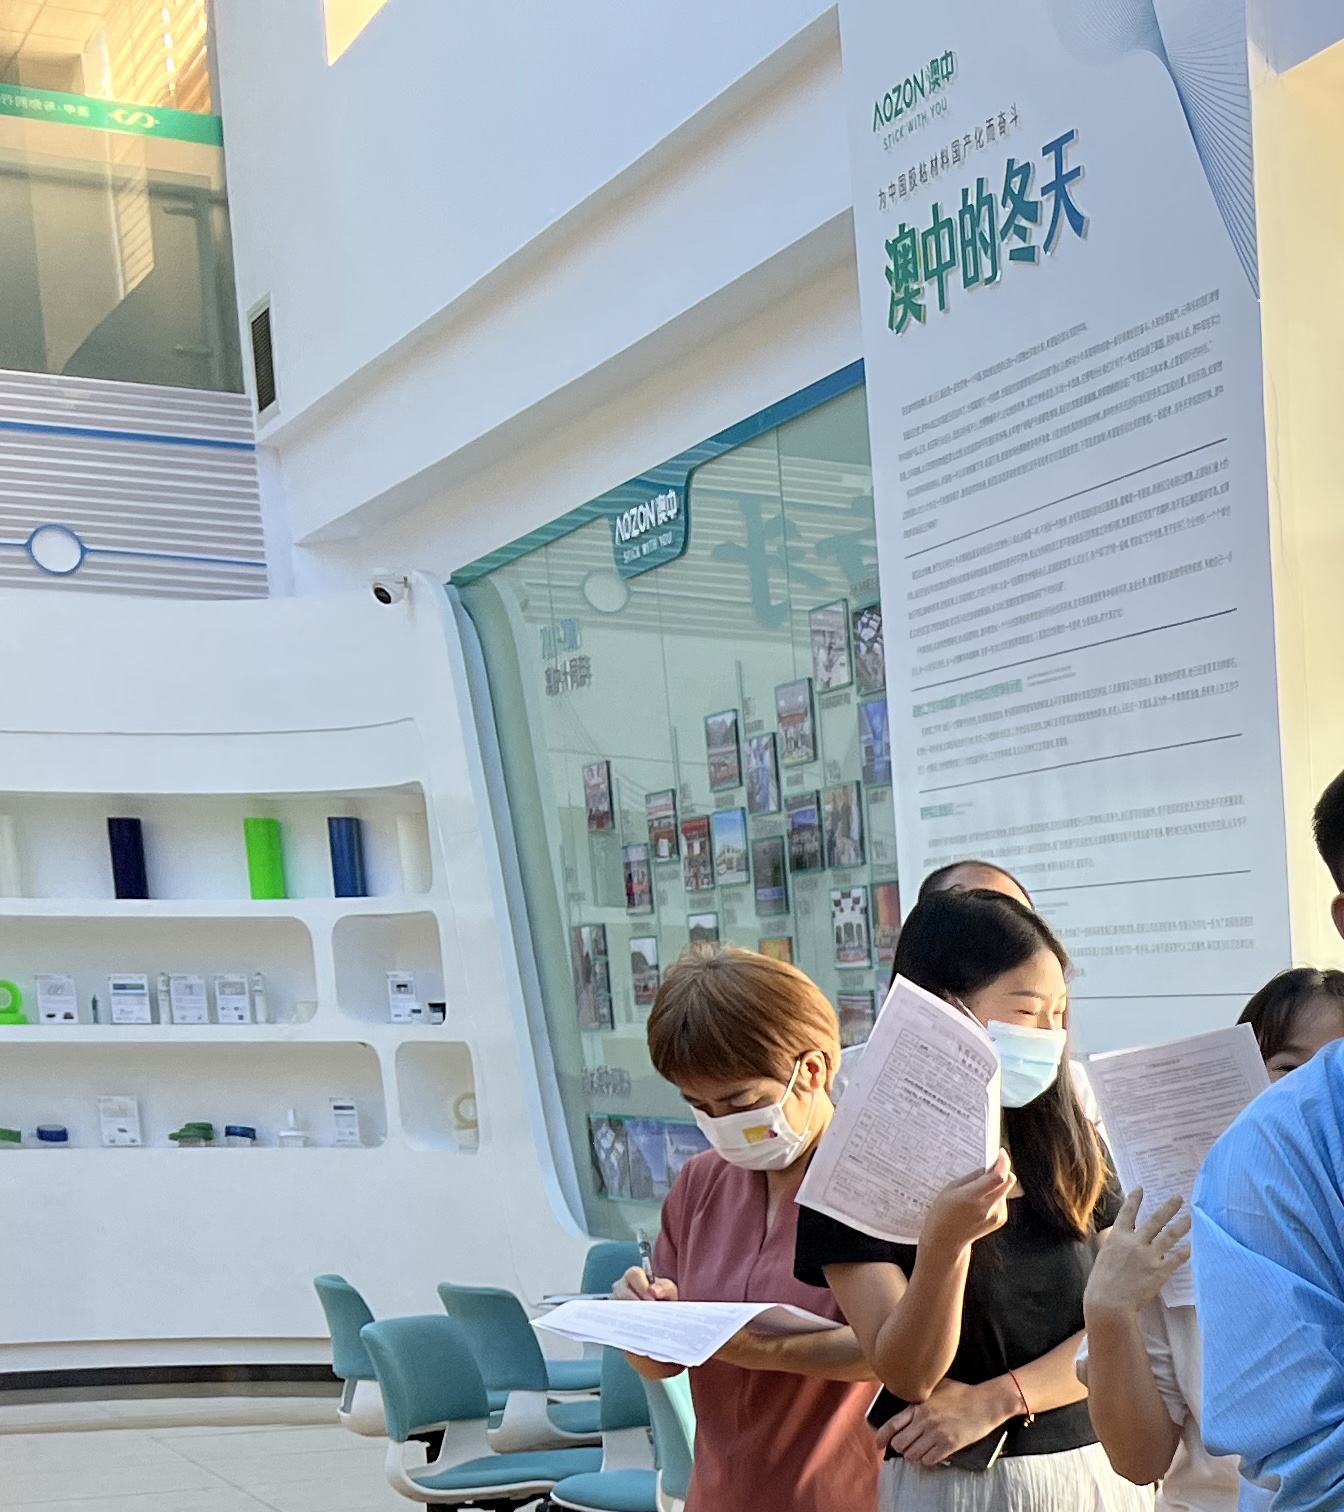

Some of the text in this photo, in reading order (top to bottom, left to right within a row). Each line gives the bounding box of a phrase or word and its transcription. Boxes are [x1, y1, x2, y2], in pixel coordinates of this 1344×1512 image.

[878, 102, 1018, 210] 为中国胶粘材料国产化而奋斗
[883, 97, 948, 151] STICK WITH YOU
[885, 129, 1084, 334] 澳中的冬天
